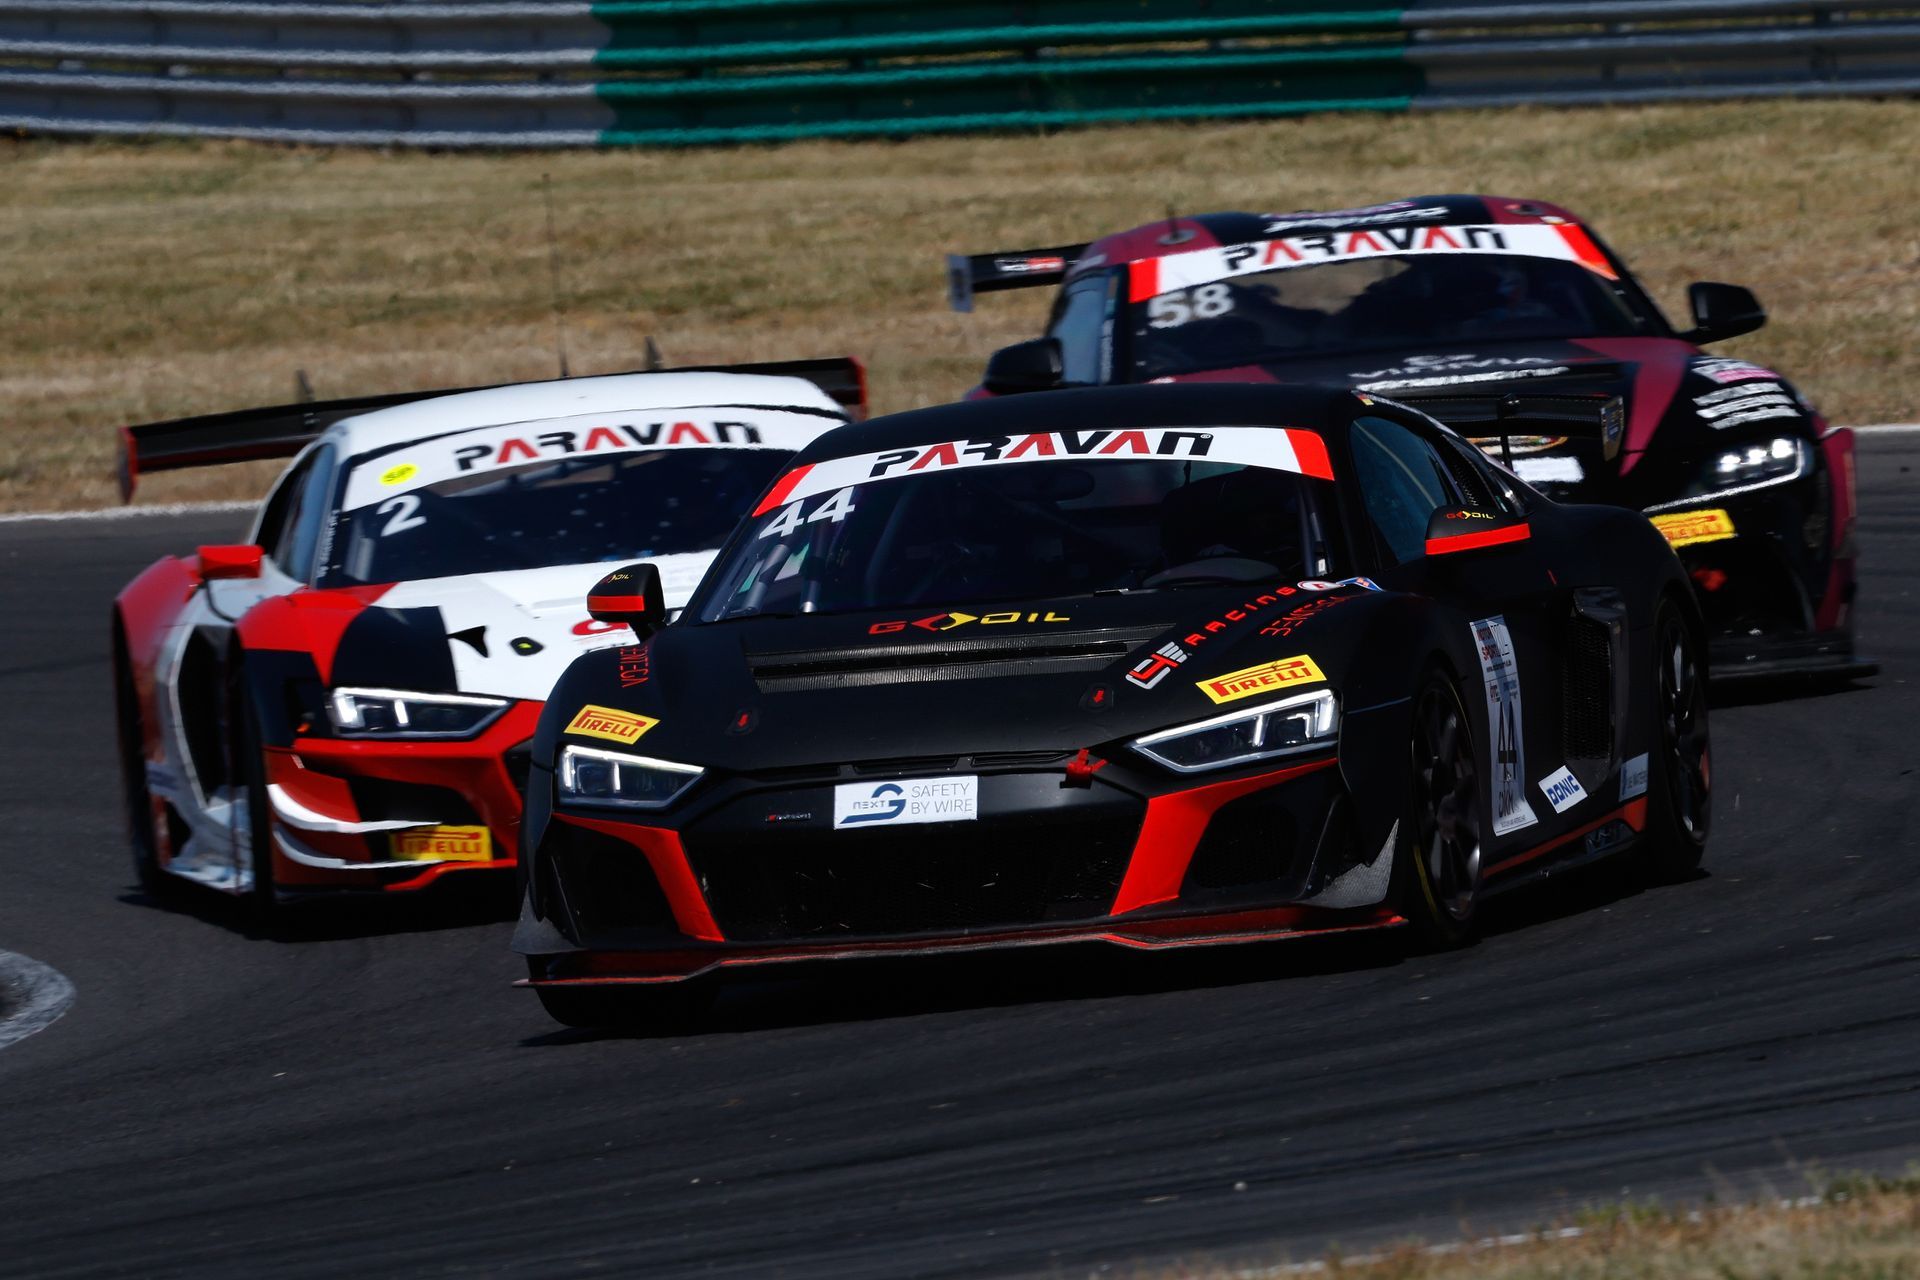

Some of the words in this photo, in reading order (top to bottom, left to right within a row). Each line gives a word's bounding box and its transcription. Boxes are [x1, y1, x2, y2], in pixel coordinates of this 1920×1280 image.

[1221, 226, 1507, 271] PARAVAN
[1148, 283, 1234, 329] 58
[454, 420, 762, 472] PARAVAN
[869, 430, 1213, 478] PARAVAN
[376, 494, 427, 537] 2
[757, 486, 856, 540] 44
[1182, 586, 1298, 647] RACING
[1208, 660, 1312, 699] PIRELLI
[573, 710, 647, 738] PIRELLI
[911, 782, 970, 798] SAFETY
[911, 801, 930, 815] BY
[934, 799, 973, 814] WIRE
[1546, 775, 1580, 806] DONIC
[394, 831, 483, 857] PIRELLI
